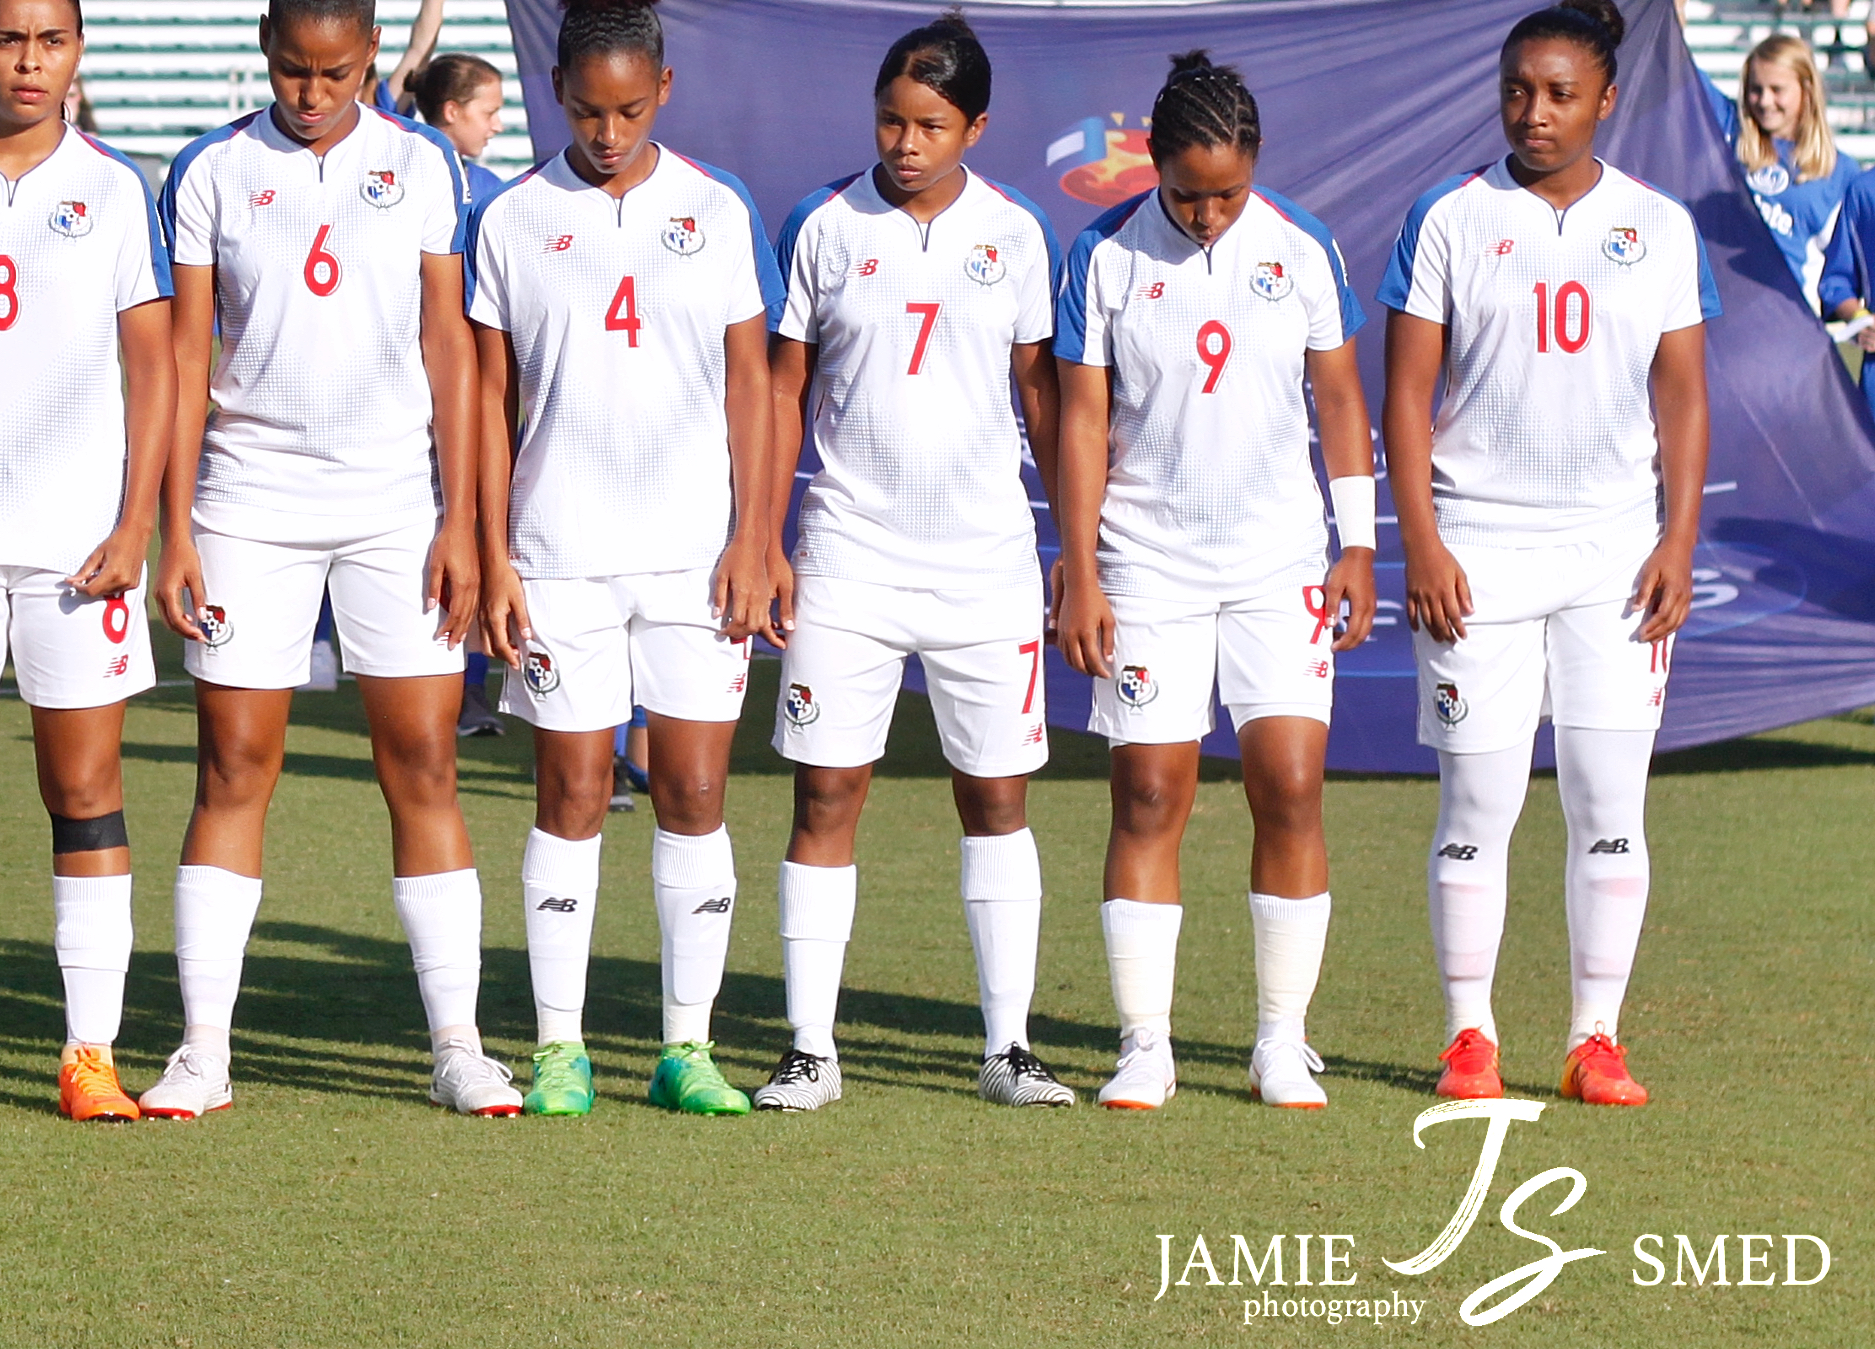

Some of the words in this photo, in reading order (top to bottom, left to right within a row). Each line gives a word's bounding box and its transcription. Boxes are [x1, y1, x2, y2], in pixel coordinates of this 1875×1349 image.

[303, 224, 342, 297] 6
[605, 275, 643, 348] 4
[906, 302, 944, 376] 7
[1533, 280, 1593, 354] 10
[1196, 319, 1234, 394] 9
[1018, 640, 1040, 714] 7
